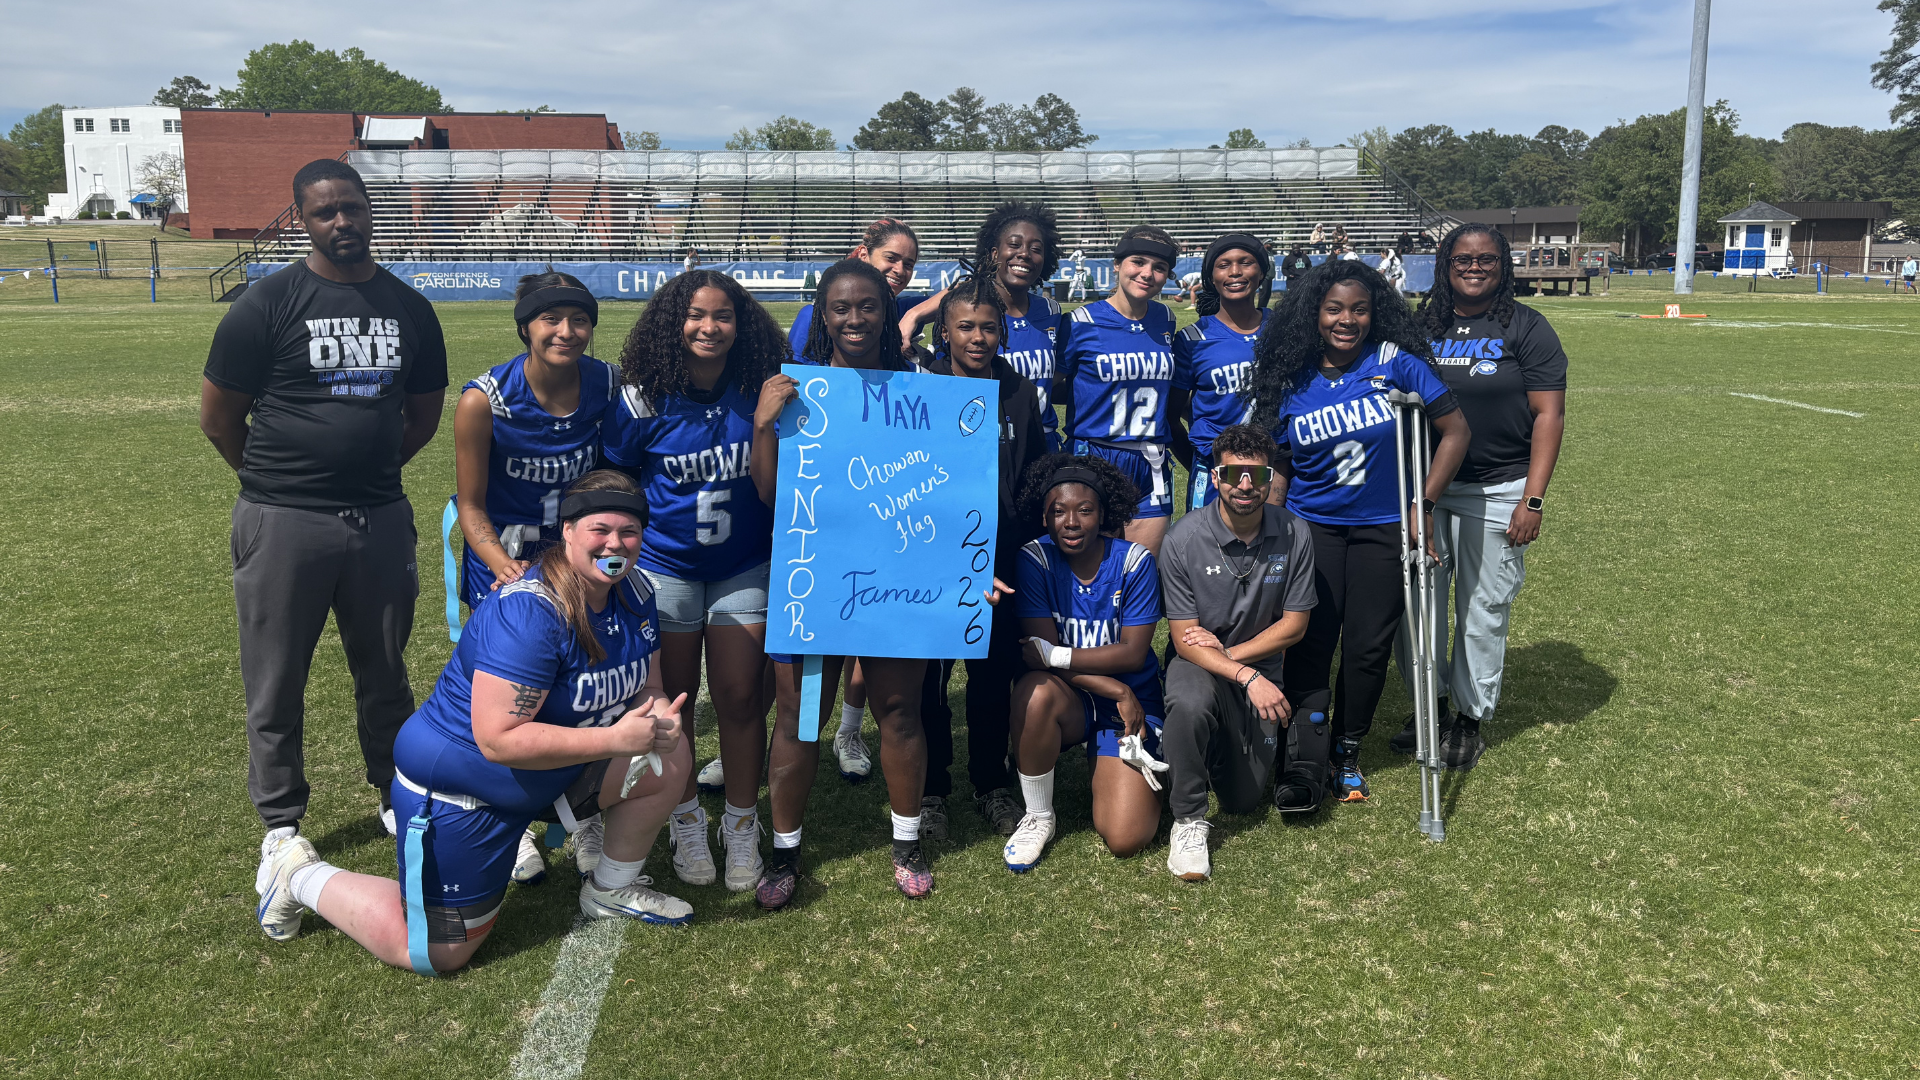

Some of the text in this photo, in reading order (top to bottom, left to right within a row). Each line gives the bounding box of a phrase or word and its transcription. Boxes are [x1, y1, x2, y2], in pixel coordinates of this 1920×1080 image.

[414, 277, 501, 291] CAROLINAS
[305, 317, 400, 338] WIN AS
[1667, 305, 1680, 318] 20
[308, 335, 402, 369] ONE
[1426, 337, 1504, 359] AWKS
[317, 370, 395, 385] HAWKS
[1211, 361, 1259, 395] CHO
[1109, 386, 1158, 437] 12
[1294, 393, 1396, 446] CHOWAN
[505, 445, 598, 484] CHOWA
[663, 441, 751, 485] CHOWA
[848, 449, 930, 490] Chowan
[1332, 440, 1366, 486] 2
[784, 377, 829, 641] SENIOR
[868, 463, 950, 520] Women's
[695, 488, 732, 547] 5
[839, 568, 943, 621] James
[958, 509, 990, 645] 2026
[572, 653, 653, 712] CHOWA
